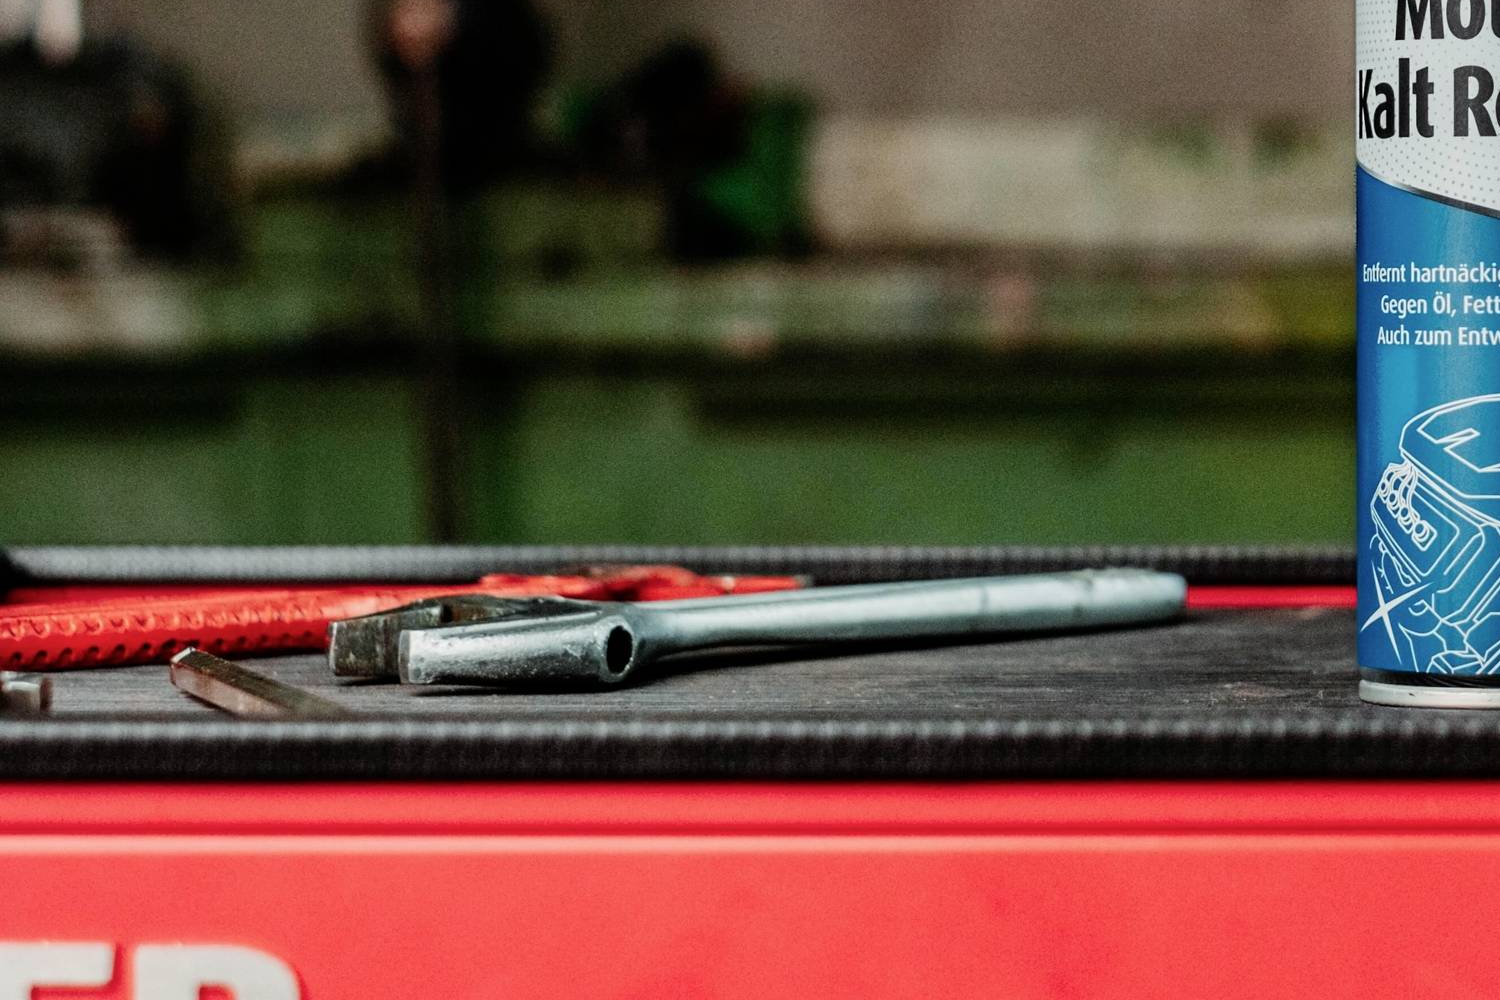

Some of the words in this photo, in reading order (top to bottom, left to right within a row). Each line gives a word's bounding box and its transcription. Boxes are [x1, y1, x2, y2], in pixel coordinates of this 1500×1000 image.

[1359, 58, 1434, 139] Kalt
[1363, 262, 1406, 283] Entfernt
[1381, 295, 1427, 319] Gegen
[1433, 291, 1456, 317] Öl,
[1464, 295, 1500, 314] Fett
[1377, 325, 1410, 345] Auch
[1415, 330, 1451, 345] zum
